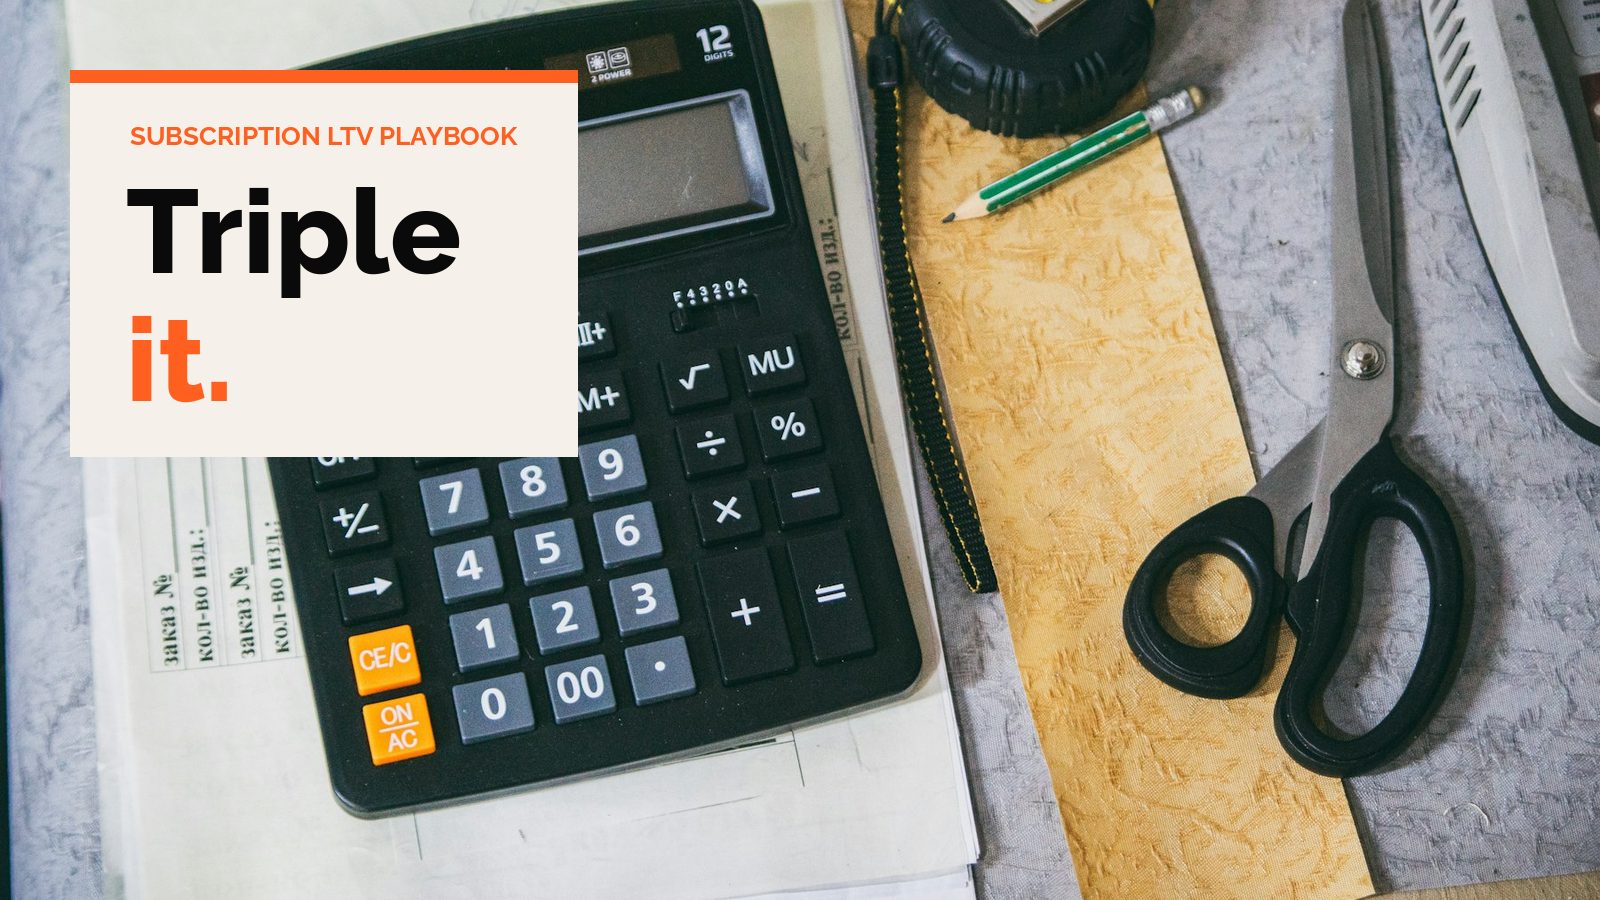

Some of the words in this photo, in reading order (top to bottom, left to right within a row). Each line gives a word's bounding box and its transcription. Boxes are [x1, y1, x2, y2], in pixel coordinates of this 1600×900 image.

[695, 24, 732, 53] 12
[704, 49, 734, 62] DIGITS
[591, 74, 598, 83] 2
[599, 68, 632, 81] POWER
[672, 290, 682, 302] F
[686, 288, 696, 299] 4
[699, 286, 708, 296] 3
[712, 283, 721, 294] 2
[738, 278, 748, 289] A
[748, 347, 793, 375] MU
[578, 387, 619, 412] M+
[771, 412, 805, 439] %
[599, 449, 622, 479] 9
[521, 466, 546, 496] 8
[440, 482, 462, 513] 7
[616, 515, 639, 545] 6
[190, 529, 207, 578] изд.:
[536, 532, 559, 563] 5
[229, 566, 250, 590] №
[457, 550, 482, 579] 4
[152, 574, 174, 598] №
[632, 583, 656, 614] 3
[193, 586, 214, 662] кол-во
[237, 597, 256, 659] заказ
[270, 577, 290, 654] кол-во
[552, 601, 578, 633] 2
[161, 605, 179, 666] заказ
[476, 618, 495, 648] 1
[359, 642, 411, 672] CE/C
[558, 667, 603, 703] 00
[380, 703, 413, 725] ON
[481, 688, 506, 719] 0
[388, 728, 418, 753] AC
